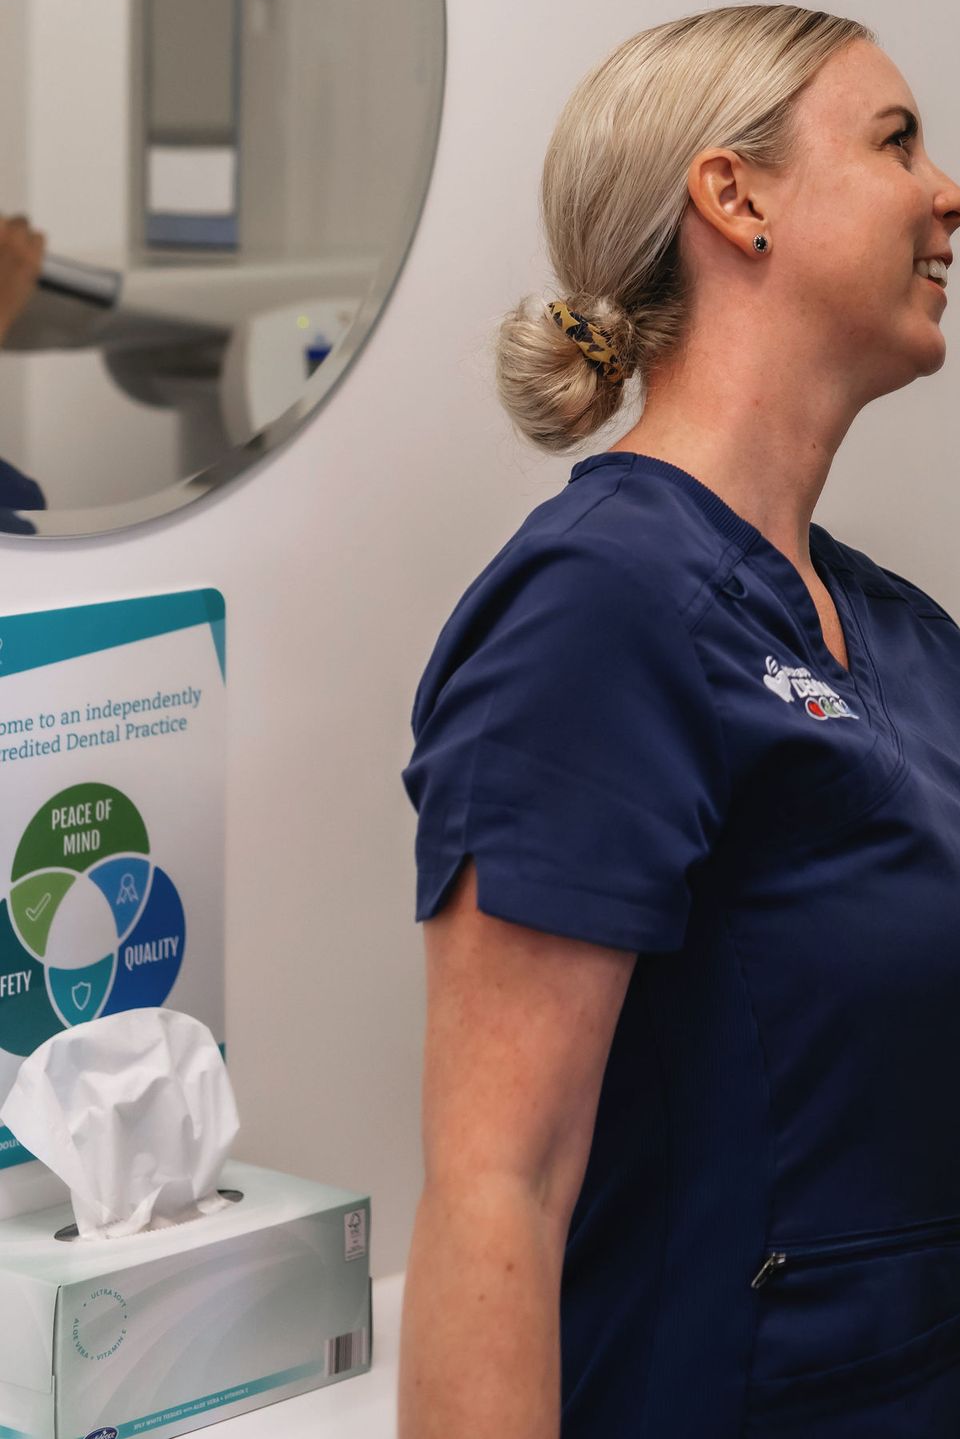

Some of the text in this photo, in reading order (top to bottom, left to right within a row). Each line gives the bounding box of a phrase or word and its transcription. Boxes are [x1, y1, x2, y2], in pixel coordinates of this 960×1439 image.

[39, 713, 55, 729] to
[60, 710, 81, 726] an
[86, 686, 202, 721] independently
[66, 725, 120, 751] Dental
[125, 716, 188, 740] Practice
[51, 798, 112, 831] PEACE OF
[63, 829, 100, 856] MIND
[124, 936, 179, 971] QUALITY
[0, 969, 32, 998] FETY
[91, 1288, 126, 1307] ULTRA SOFT
[72, 1318, 89, 1358] ALOE VERA
[96, 1336, 124, 1360] VITAMIN
